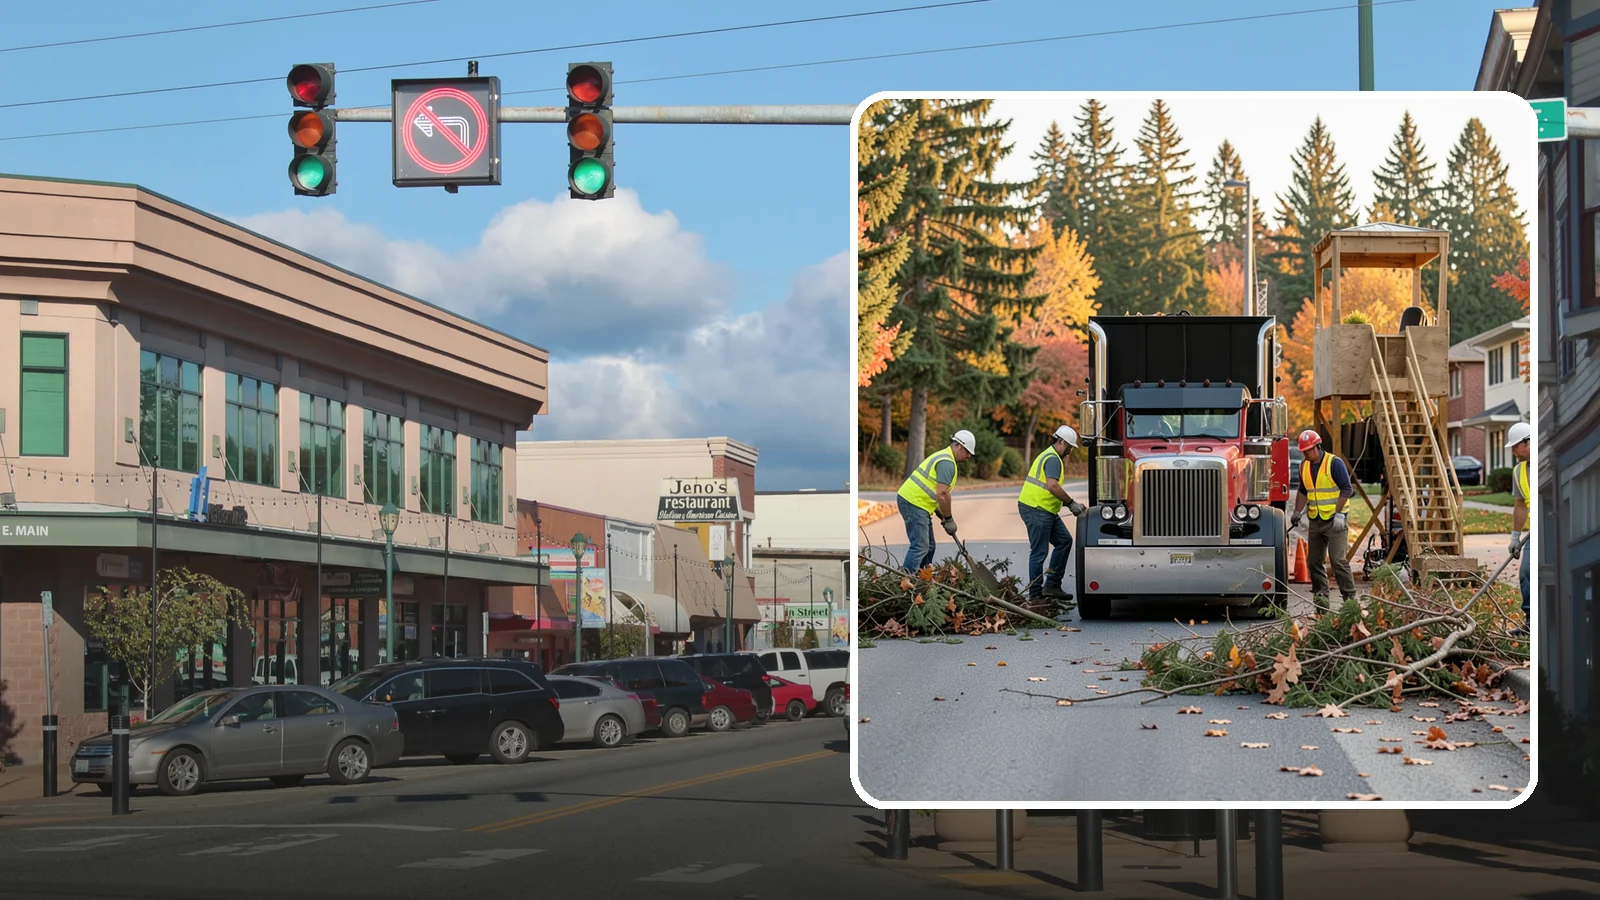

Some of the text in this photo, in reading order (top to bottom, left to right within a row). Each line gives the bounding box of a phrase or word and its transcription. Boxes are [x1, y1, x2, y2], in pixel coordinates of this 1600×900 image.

[670, 480, 728, 495] Jeno's
[665, 496, 731, 509] restaurant
[686, 509, 714, 519] American
[715, 509, 737, 519] Cuisine
[2, 525, 49, 536] E. MAIN
[798, 608, 828, 616] Street
[791, 619, 823, 627] lass
